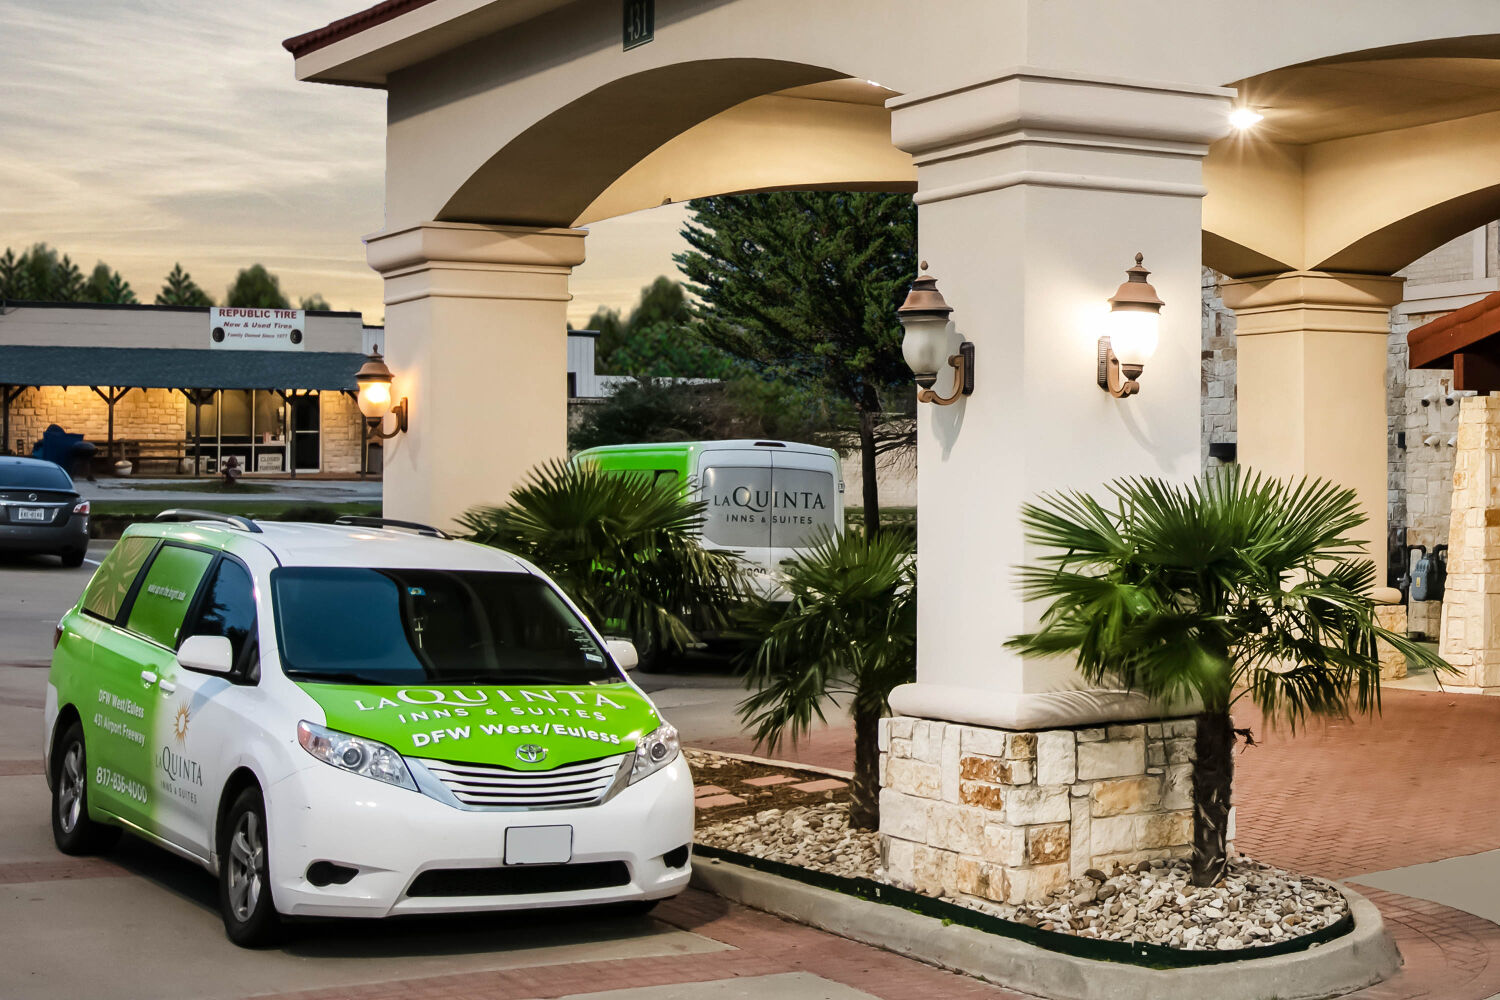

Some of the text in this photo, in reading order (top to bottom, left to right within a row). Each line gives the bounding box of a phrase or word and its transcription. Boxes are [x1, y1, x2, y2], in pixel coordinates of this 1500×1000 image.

[219, 308, 297, 319] REPUBLIC TIRE
[714, 486, 825, 513] LA QUINTA
[726, 515, 755, 523] INNS
[772, 516, 813, 525] SUITES
[98, 689, 145, 719] DFW West/Euless
[354, 689, 626, 711] LA QUINTA
[398, 707, 607, 725] INNS & SUITES
[103, 717, 122, 736] Airport
[122, 723, 146, 747] Freeway
[412, 722, 621, 748] DFW West/Euless
[162, 746, 203, 787] QUINTA
[96, 766, 148, 804] 817-836-4000
[161, 781, 173, 793] INNS
[178, 787, 198, 804] SUITES
